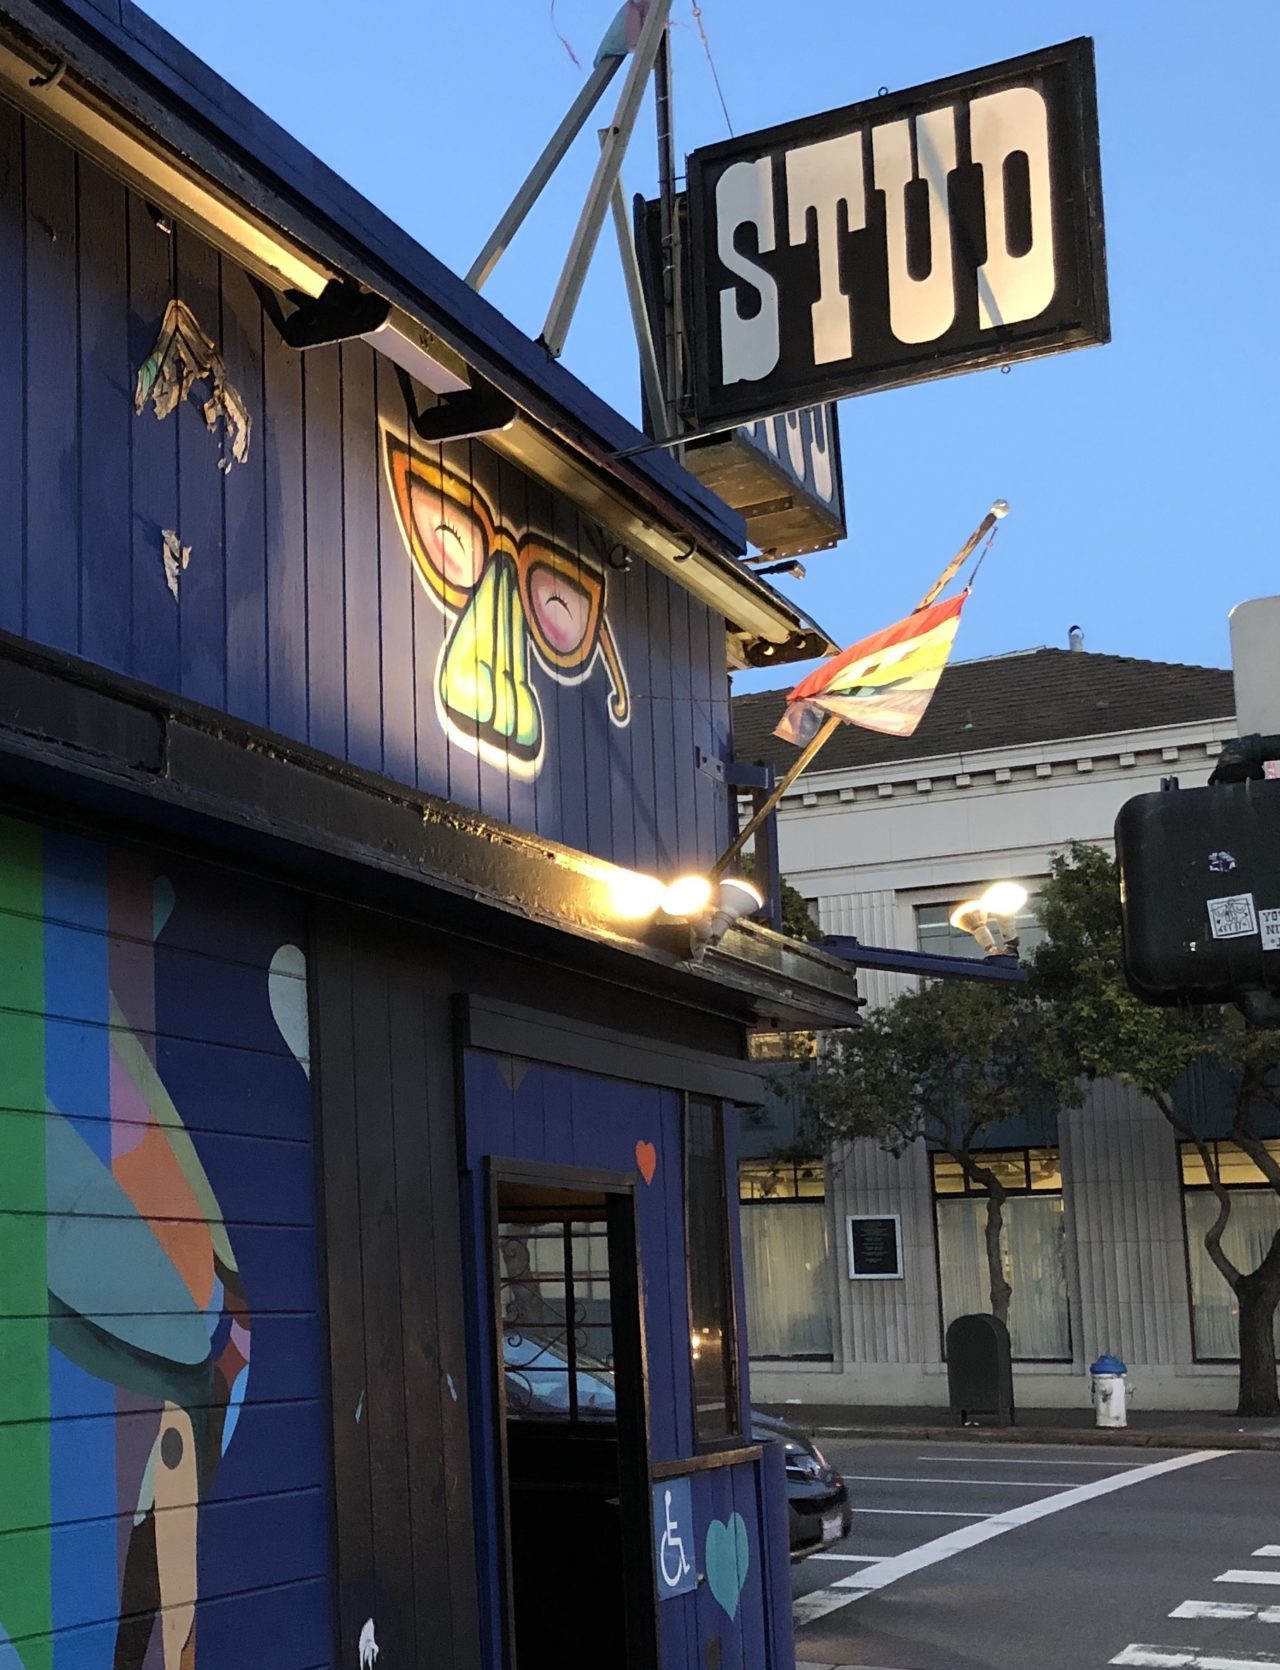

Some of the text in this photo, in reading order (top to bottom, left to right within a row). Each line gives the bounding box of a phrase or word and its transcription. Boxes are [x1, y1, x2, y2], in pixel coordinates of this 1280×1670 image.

[716, 87, 1055, 385] STUD
[1262, 911, 1280, 922] YO
[1266, 925, 1280, 935] NI
